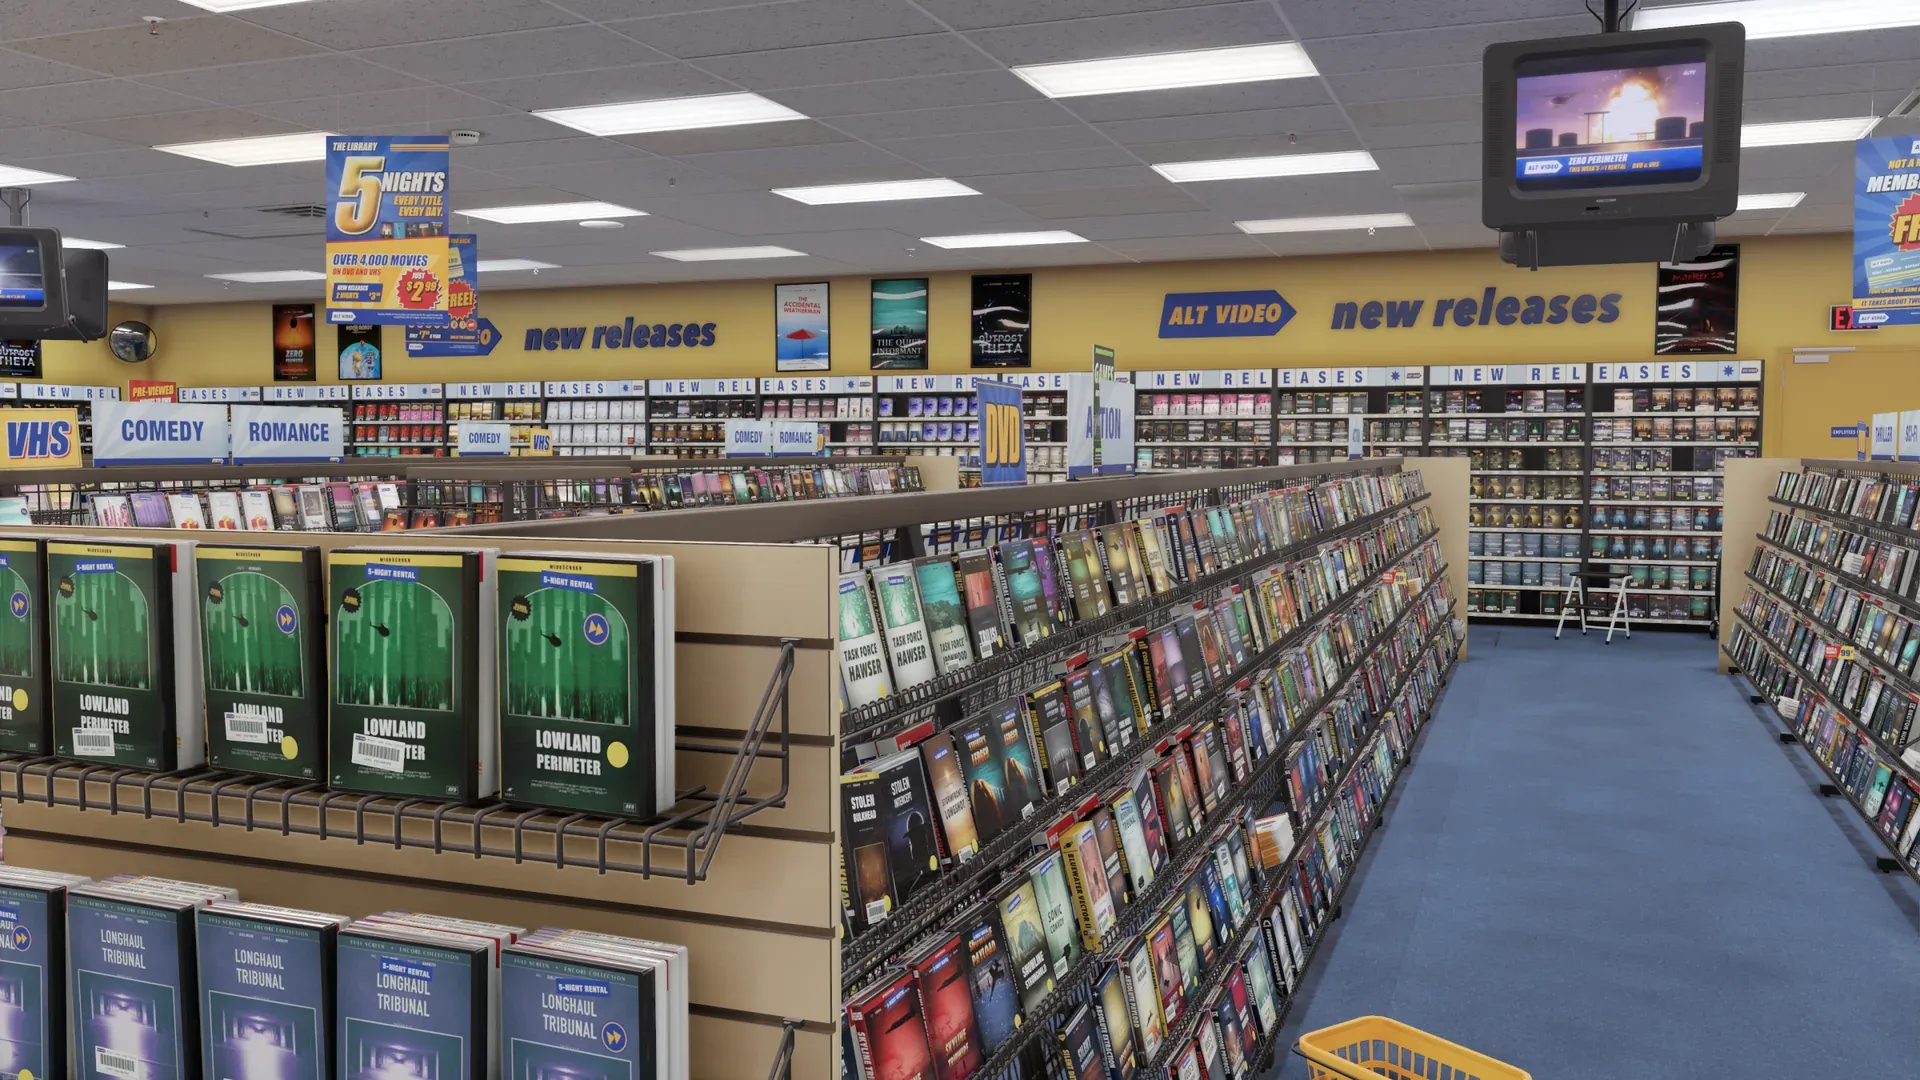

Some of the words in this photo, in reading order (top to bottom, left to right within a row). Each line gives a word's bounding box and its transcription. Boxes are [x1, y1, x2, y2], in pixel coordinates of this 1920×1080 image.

[333, 142, 346, 151] THE
[347, 142, 378, 151] LIBRARY
[1568, 157, 1586, 166] ZERO
[1588, 154, 1628, 164] PERIMETER
[1888, 159, 1908, 170] NOT
[1908, 158, 1915, 168] A
[1866, 173, 1920, 193] MEMB
[334, 156, 386, 235] 5
[382, 172, 446, 192] NIGHTS
[394, 196, 418, 205] EVERY
[398, 206, 422, 217] EVERY
[333, 254, 358, 266] OVER
[360, 254, 388, 266] 4,000
[390, 255, 428, 266] MOVIES
[1168, 306, 1206, 326] ALT
[1216, 302, 1282, 324] VIDEO
[1331, 299, 1424, 330] new
[1432, 286, 1624, 328] releases
[524, 326, 587, 351] new
[591, 316, 716, 349] releases
[877, 339, 894, 347] THE
[978, 334, 1024, 343] OUTPOST
[978, 343, 1024, 354] THETA
[1094, 362, 1114, 384] GAMES
[1157, 374, 1200, 386] NEW
[1454, 368, 1504, 382] NEW
[38, 386, 70, 397] NEW
[132, 385, 174, 397] PRE-VIEWED
[277, 388, 304, 398] NEW
[461, 385, 490, 395] NEW
[666, 381, 700, 393] NEW
[896, 378, 934, 390] NEW
[122, 419, 204, 442] COMEDY
[249, 422, 329, 442] ROMANCE
[1086, 406, 1121, 439] ATION
[7, 420, 70, 458] VHS
[469, 433, 501, 443] COMEDY
[533, 435, 550, 450] VHS
[734, 430, 763, 444] COMEDY
[780, 431, 812, 444] ROMANCE
[986, 402, 1020, 465] DVD
[1876, 426, 1892, 442] THRILLER
[98, 562, 114, 570] RENTAL
[368, 568, 392, 578] 5-NIGHT
[394, 569, 416, 580] RENTAL
[543, 576, 568, 586] 5-NIGHT
[570, 578, 594, 589] RENTAL
[892, 635, 906, 648] TASK
[906, 630, 922, 644] FORCE
[844, 649, 859, 662] TASK
[860, 643, 877, 657] FORCE
[896, 645, 927, 667] HAWSER
[848, 659, 882, 682] HAWSER
[80, 694, 130, 715] LOWLAND
[233, 702, 284, 724] LOWLAND
[81, 715, 130, 735] PERIMETER
[363, 718, 426, 740] LOWLAND
[536, 729, 602, 755] LOWLAND
[536, 753, 601, 776] PERIMETER
[891, 776, 911, 796] STOLEN
[850, 794, 876, 810] STOLEN
[853, 810, 877, 823] BULKHEAD
[1068, 854, 1083, 894] BLUEWATER
[1078, 895, 1090, 923] VECTOR
[136, 908, 167, 918] COLLECTION
[101, 928, 145, 950] LONGHAUL
[276, 926, 309, 937] COLLECTION
[102, 947, 146, 969] TRIBUNAL
[234, 948, 285, 970] LONGHAUL
[364, 941, 385, 950] SCREEN
[422, 949, 459, 961] COLLECTION
[236, 967, 285, 990] TRIBUNAL
[382, 962, 406, 974] 5-NIGHT
[407, 968, 430, 979] RENTAL
[530, 960, 550, 969] SCREEN
[588, 969, 626, 982] COLLECTION
[376, 972, 430, 996] LONGHAUL
[558, 983, 582, 993] 5-NIGHT
[584, 986, 608, 996] RENTAL
[377, 993, 430, 1018] TRIBUNAL
[542, 992, 597, 1017] LONGHAUL
[542, 1014, 597, 1040] TRIBUNAL
[857, 1031, 872, 1066] SKYLINE
